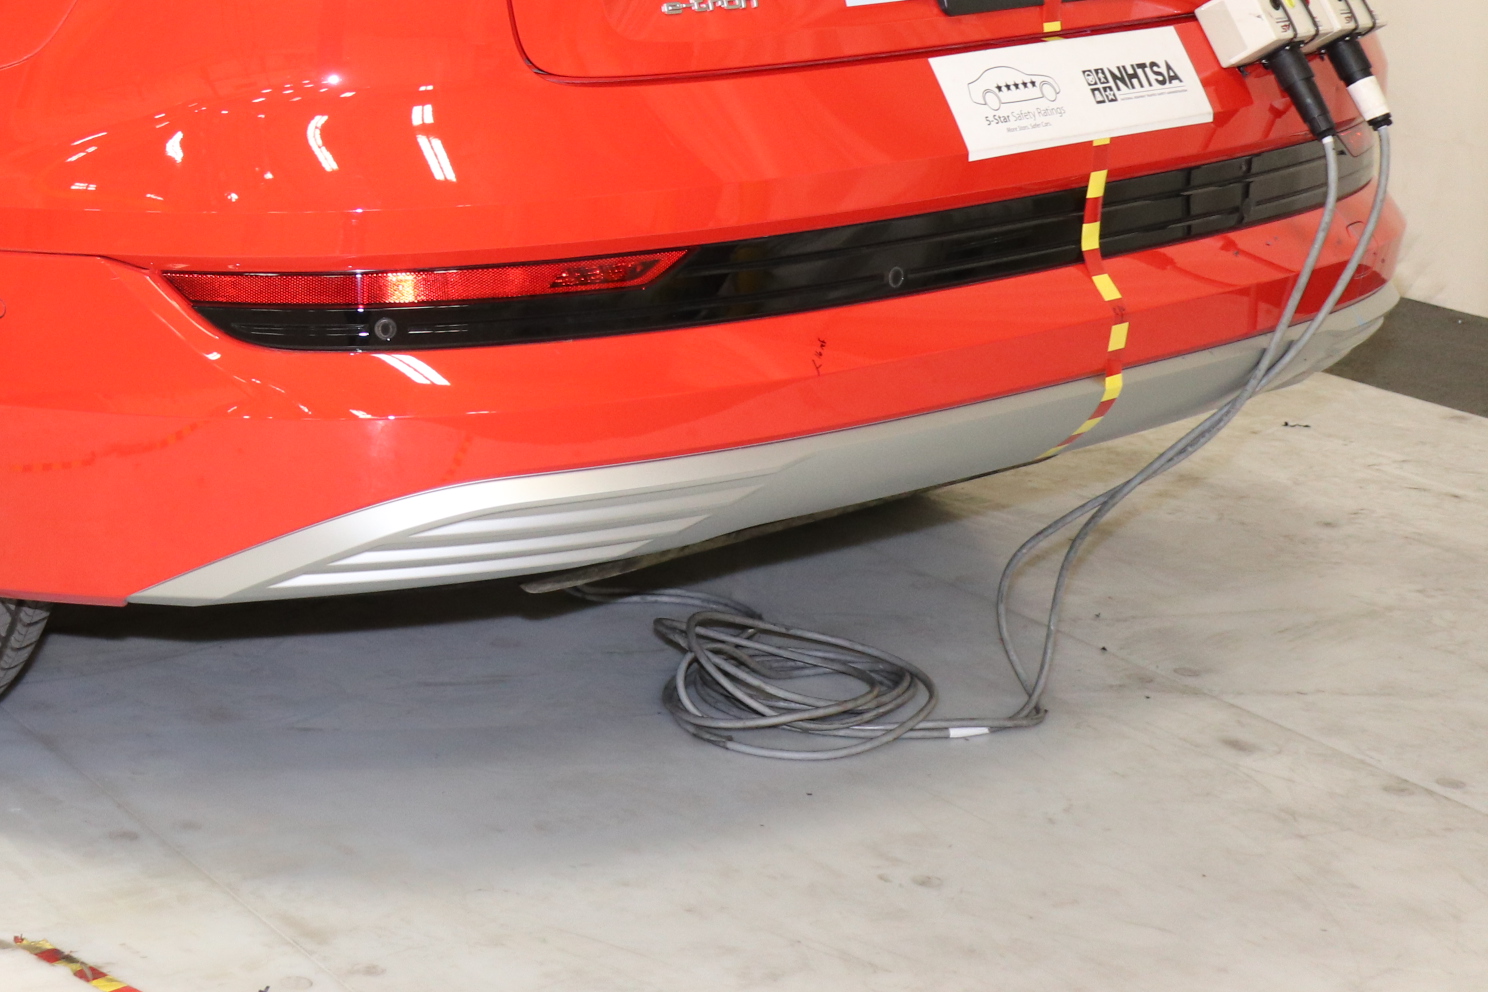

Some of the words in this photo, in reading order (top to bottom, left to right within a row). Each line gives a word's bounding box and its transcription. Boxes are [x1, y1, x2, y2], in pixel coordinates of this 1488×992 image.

[1106, 59, 1183, 92] NHTSA
[984, 114, 1010, 126] 5-Star
[1011, 108, 1037, 121] Safety
[1036, 106, 1066, 118] Ratings
